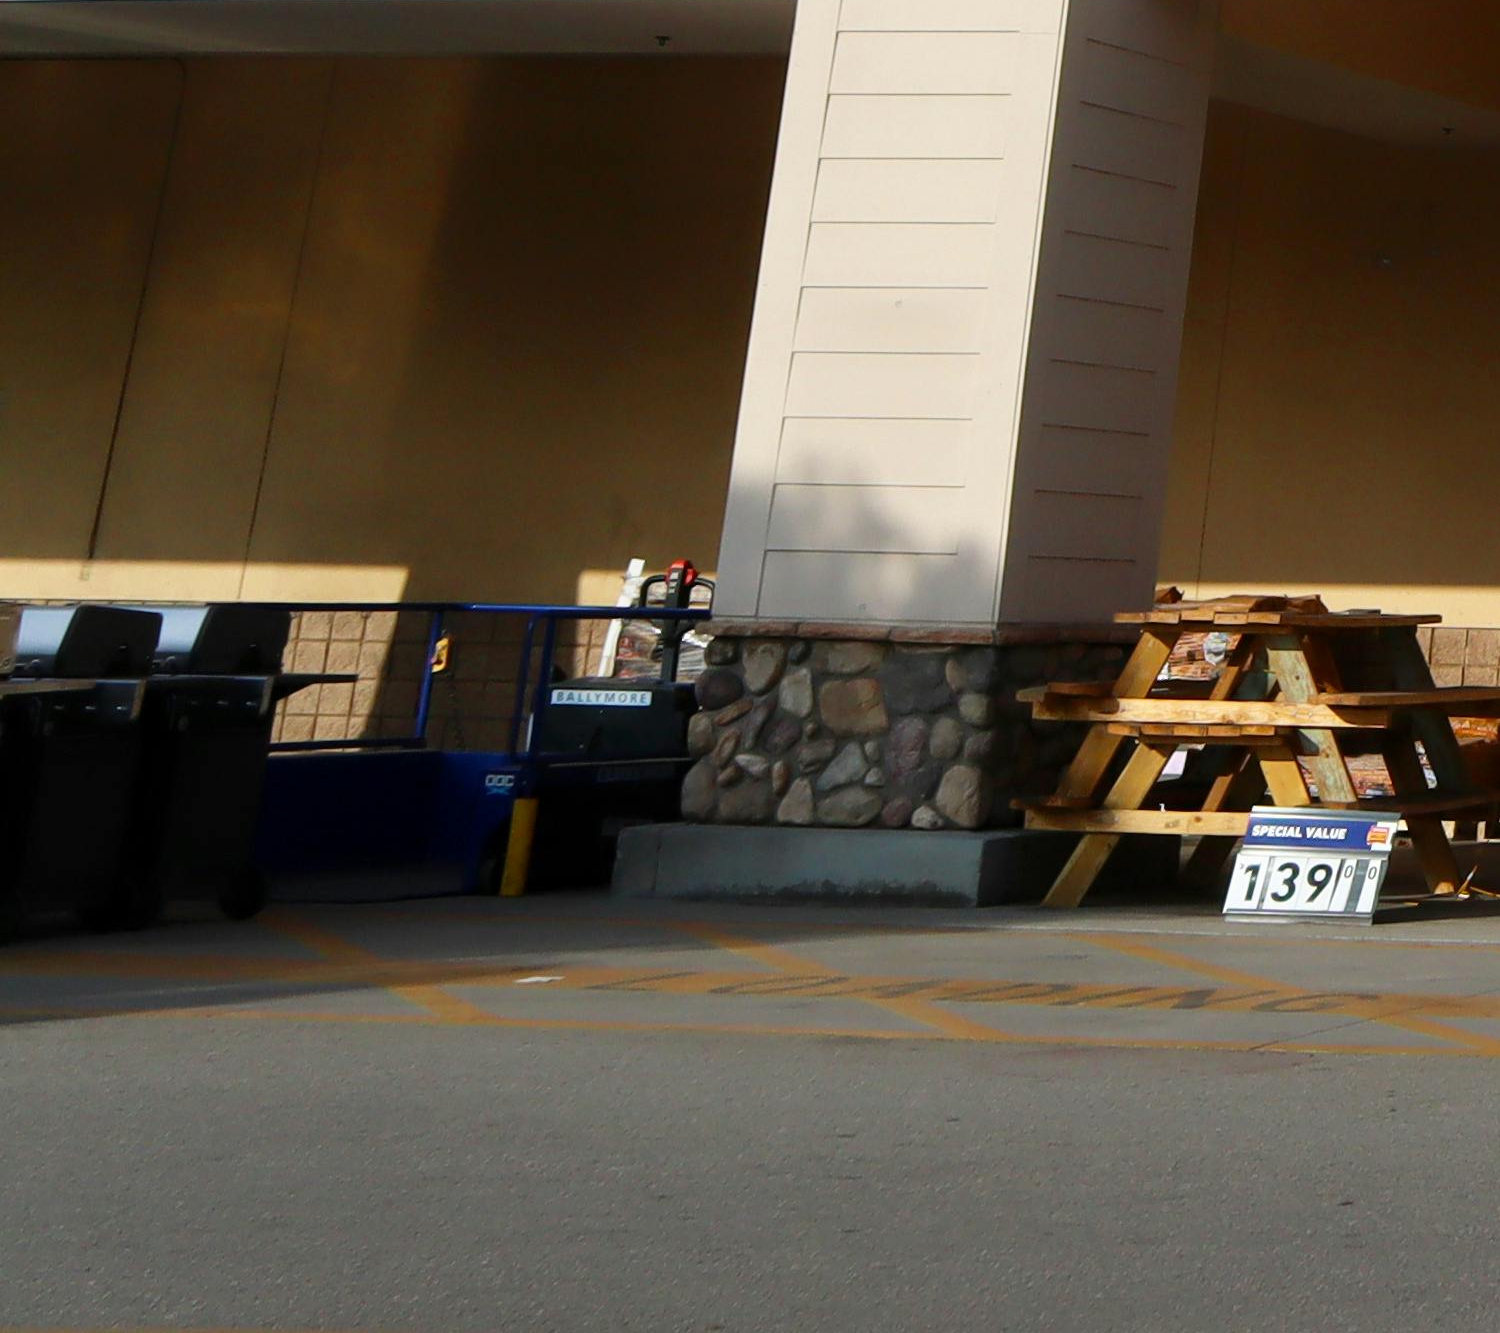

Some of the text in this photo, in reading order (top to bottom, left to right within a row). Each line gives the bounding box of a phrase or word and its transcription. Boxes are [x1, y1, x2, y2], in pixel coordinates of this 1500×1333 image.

[556, 691, 648, 704] BALLYMORE
[1252, 824, 1348, 841] SPECIAL VALUE
